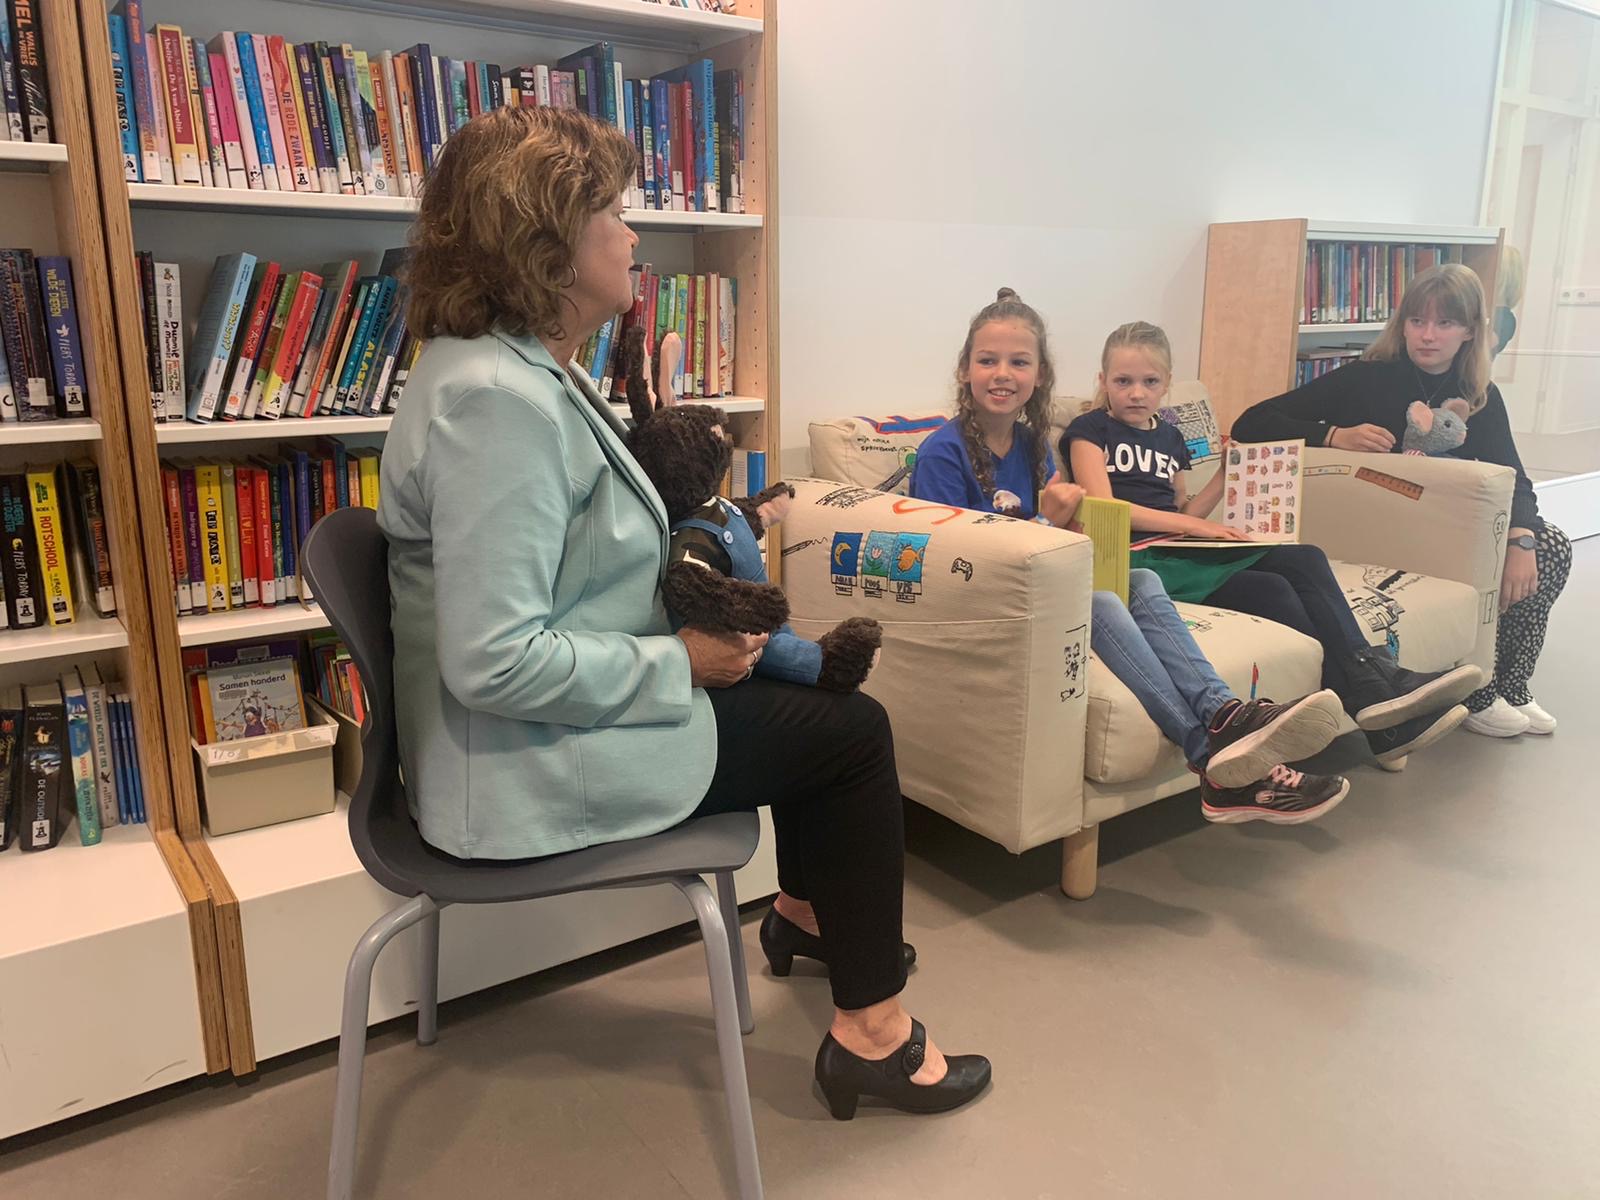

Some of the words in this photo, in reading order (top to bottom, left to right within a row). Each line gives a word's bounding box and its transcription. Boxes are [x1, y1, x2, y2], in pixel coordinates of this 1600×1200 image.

[18, 39, 29, 65] VRIES
[25, 31, 38, 67] WALLIS
[163, 36, 174, 63] Abeltje
[173, 107, 184, 133] Abeltje
[282, 91, 293, 105] DE
[284, 106, 297, 132] RODE
[290, 134, 304, 168] ZWAAN
[45, 268, 59, 291] WILDE
[47, 292, 62, 318] DIEREN
[59, 337, 73, 360] PIERS
[170, 321, 180, 358] Dummie
[64, 363, 78, 386] TORDA
[355, 340, 377, 389] ALASK
[39, 515, 59, 572] ROTSCHOOL
[12, 550, 26, 570] PIERS
[17, 572, 31, 598] TORDAY
[219, 681, 249, 691] Samen
[250, 674, 286, 686] honderd
[92, 700, 103, 722] WERELD
[37, 779, 46, 789] DE
[34, 790, 48, 821] OUTSIDE
